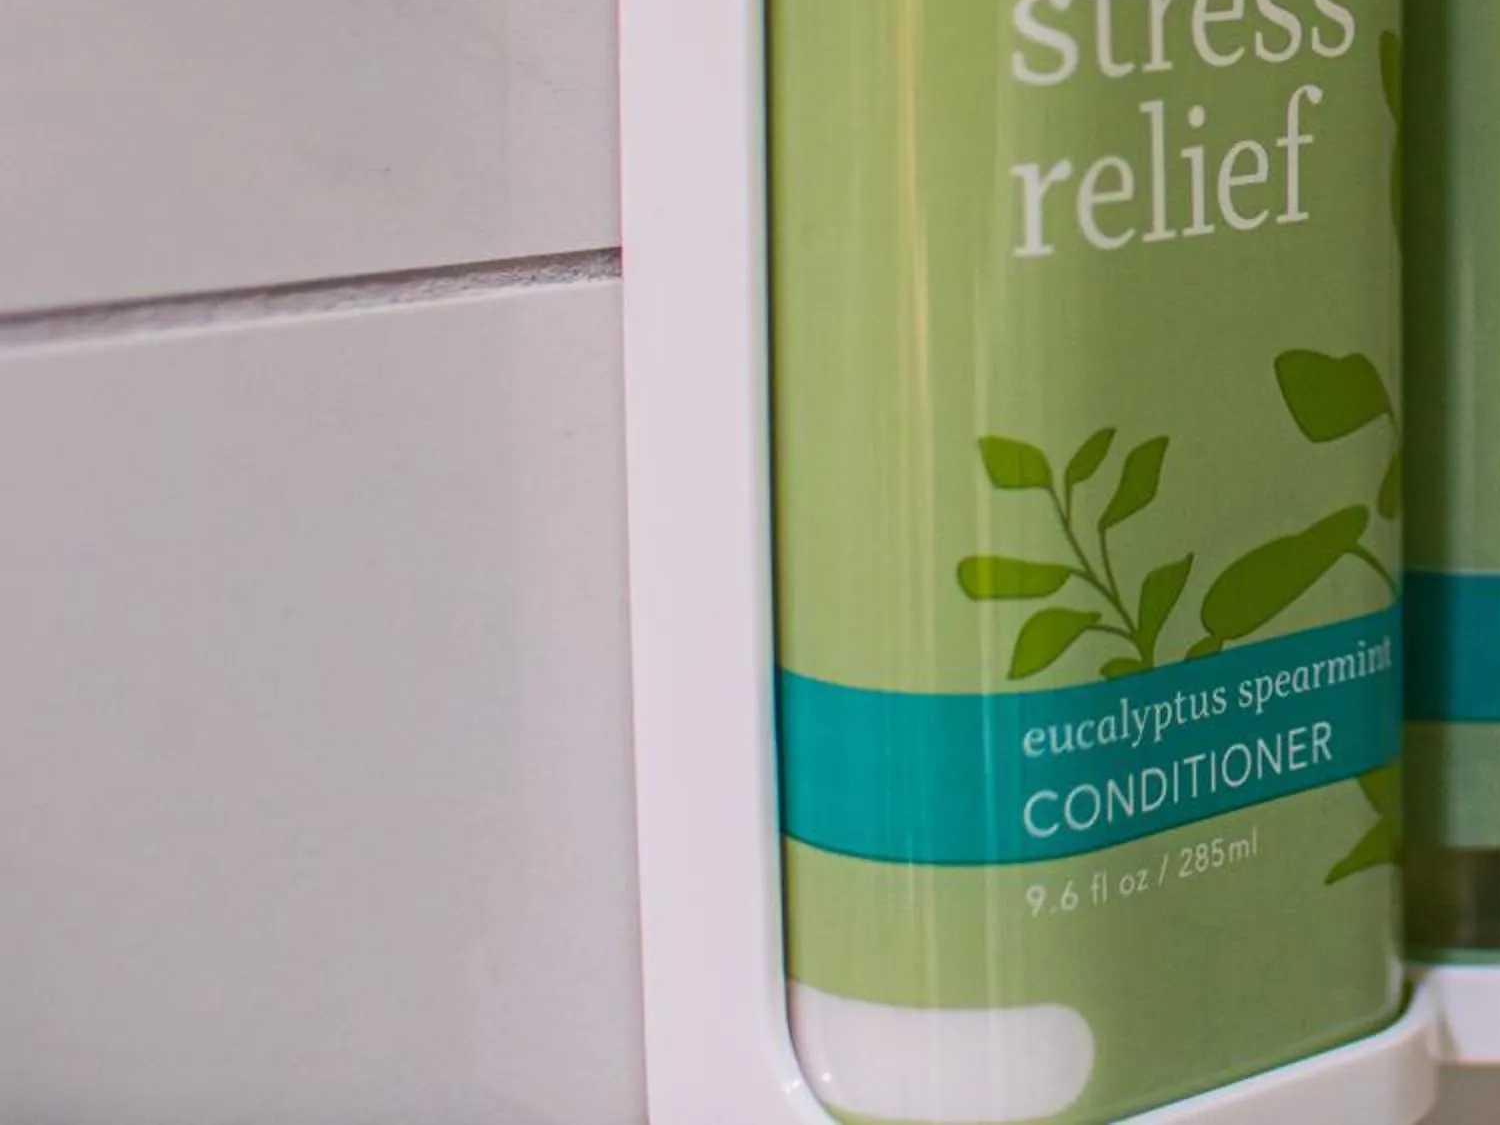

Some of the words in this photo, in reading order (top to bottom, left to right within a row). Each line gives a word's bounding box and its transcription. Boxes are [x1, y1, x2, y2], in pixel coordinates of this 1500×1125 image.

[1010, 83, 1325, 259] relief
[1022, 684, 1228, 759] eucalyptus
[1238, 636, 1392, 715] spearmint
[1022, 720, 1334, 839] CONDITIONER
[1025, 883, 1079, 917] 9.6
[1089, 870, 1109, 907] fl
[1118, 868, 1150, 897] oz
[1157, 854, 1170, 887] /
